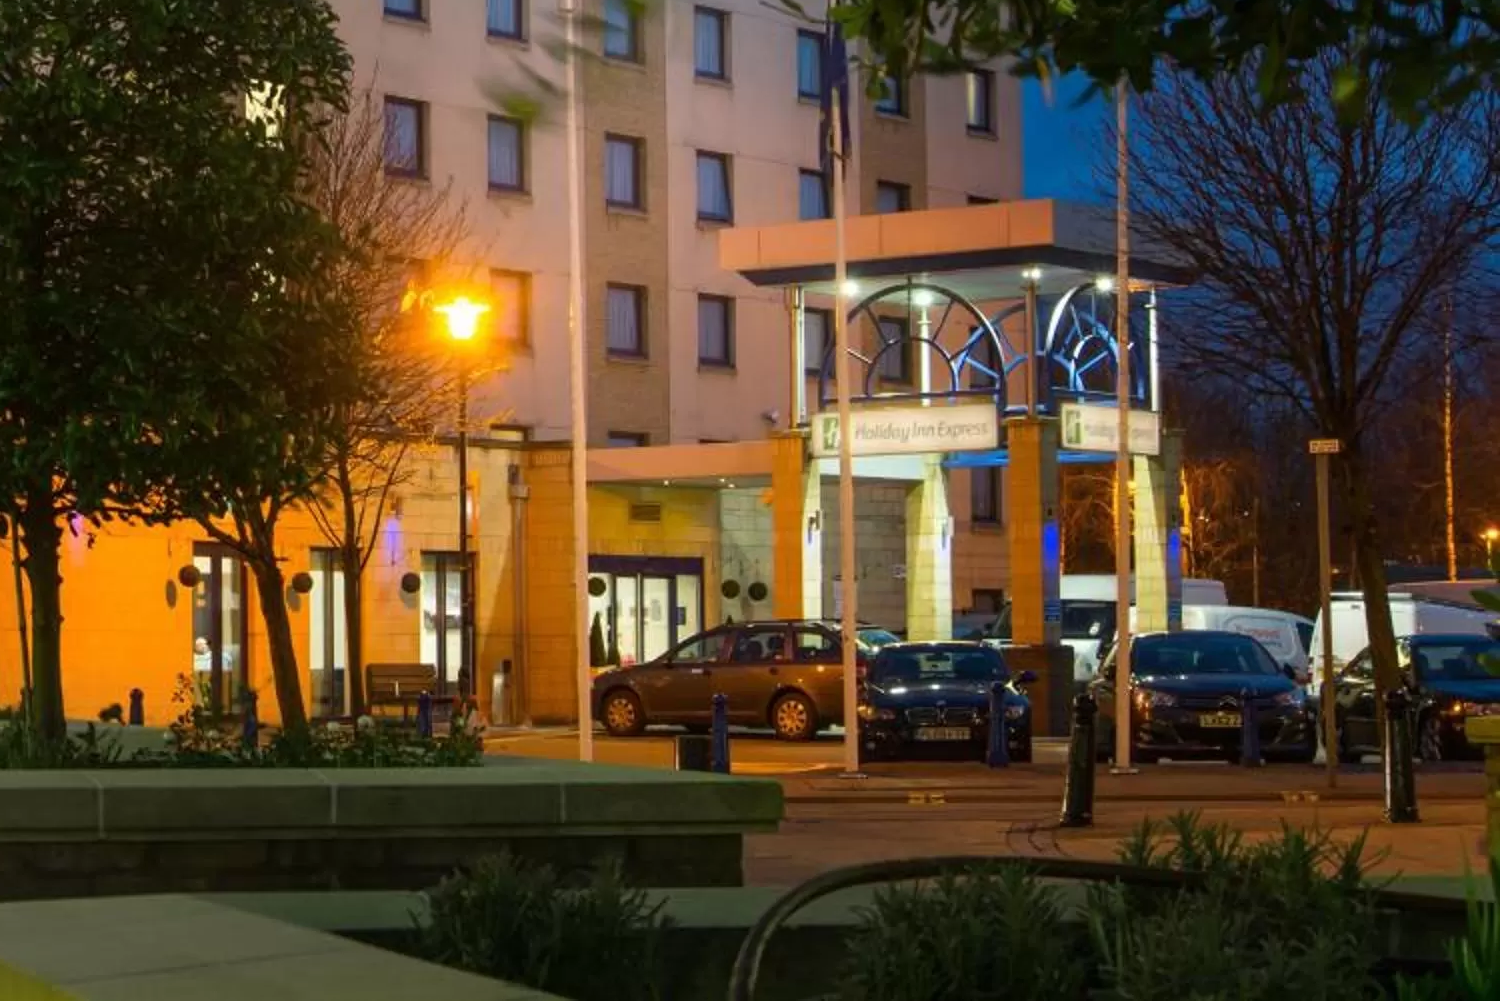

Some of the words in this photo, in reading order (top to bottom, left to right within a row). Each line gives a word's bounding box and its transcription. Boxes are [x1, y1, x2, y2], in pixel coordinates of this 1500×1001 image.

[854, 420, 911, 444] Holiday
[911, 421, 936, 439] Inn
[937, 420, 989, 440] Express
